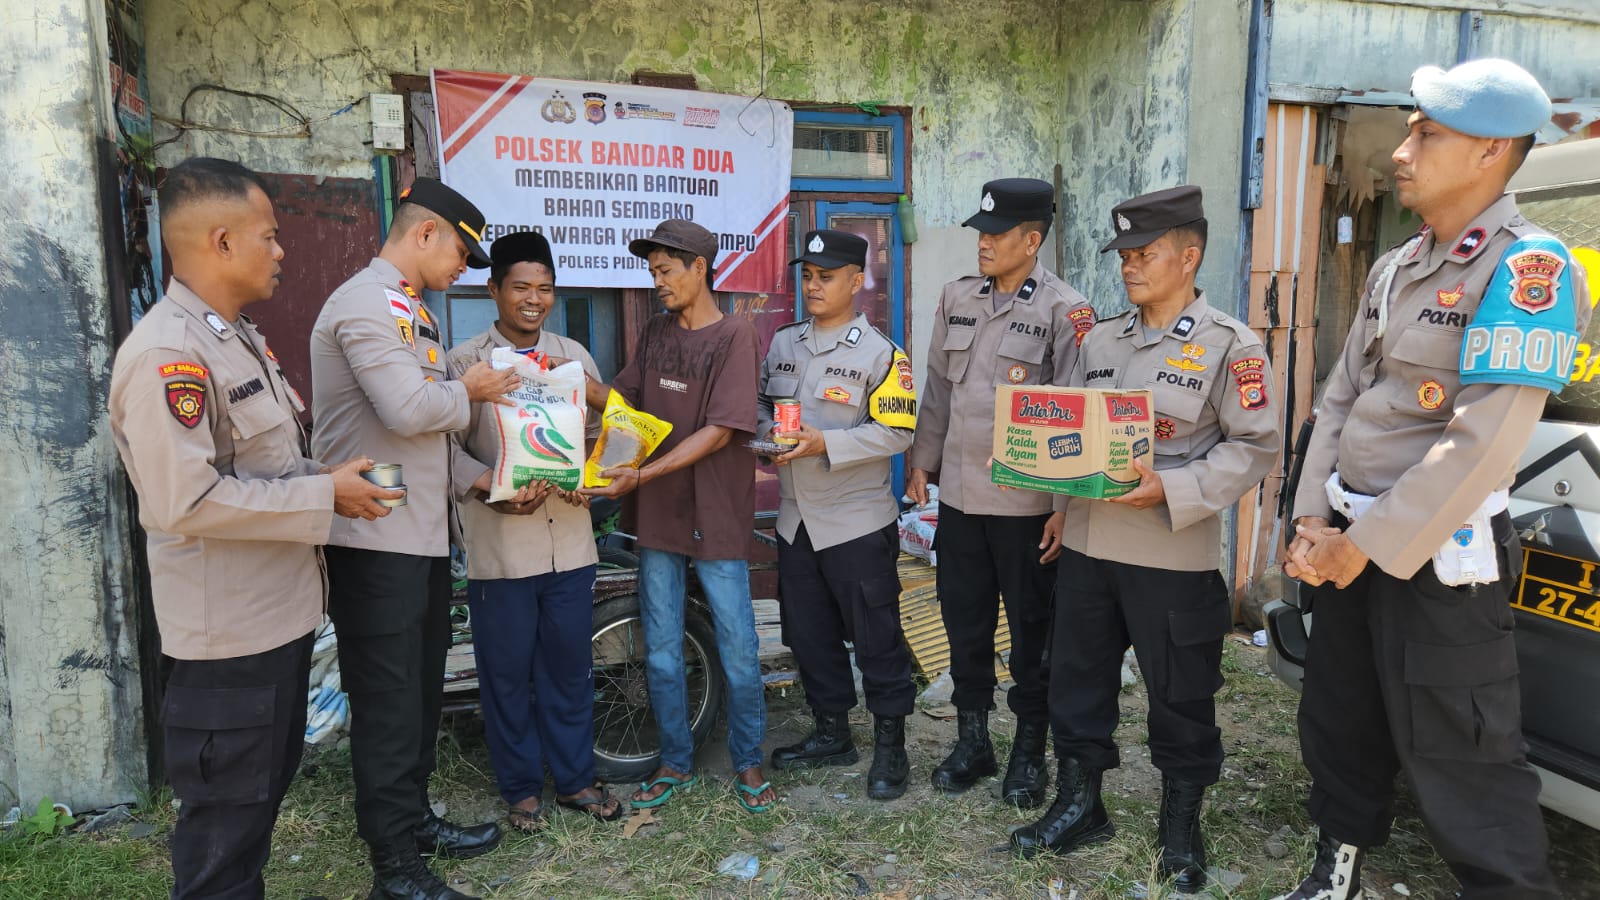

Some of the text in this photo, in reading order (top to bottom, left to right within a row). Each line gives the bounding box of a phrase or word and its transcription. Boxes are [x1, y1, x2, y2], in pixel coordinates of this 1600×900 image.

[495, 135, 735, 174] POLSEK BANDAR DUA
[515, 168, 719, 197] MEMBERIKAN BANTUAN
[544, 197, 694, 221] BAHAN SEMBAKO
[550, 225, 616, 246] WARGA
[558, 255, 609, 270] POLRES
[1417, 308, 1468, 328] POLRI
[1010, 321, 1047, 338] POLRI
[1463, 325, 1578, 378] PROV
[775, 362, 862, 381] ADI POLRI
[1156, 371, 1203, 391] POLRI
[1007, 425, 1032, 436] Rasa
[1124, 424, 1136, 437] 40
[1006, 435, 1038, 449] Kaldu
[1050, 443, 1081, 457] GURIH
[1054, 437, 1074, 448] LEBIH
[1005, 446, 1037, 461] Ayam
